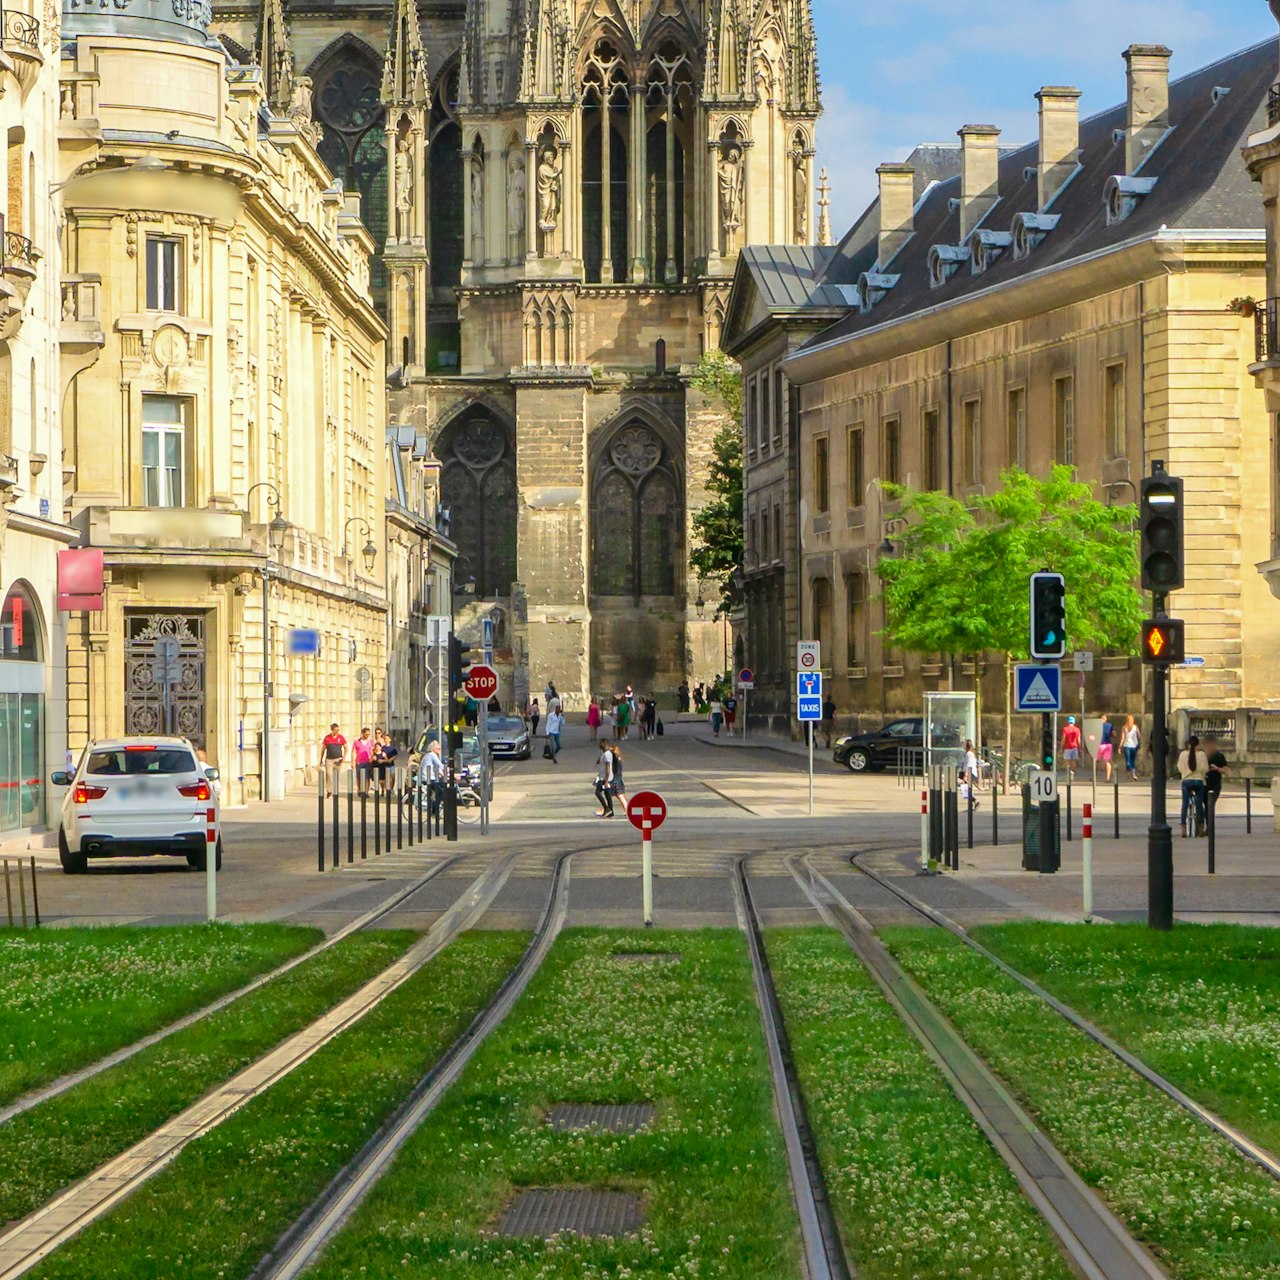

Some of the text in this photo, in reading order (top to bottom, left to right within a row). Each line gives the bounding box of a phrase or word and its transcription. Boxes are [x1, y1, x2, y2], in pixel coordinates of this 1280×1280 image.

[467, 677, 495, 688] STOP
[801, 704, 819, 712] TAXIS
[1035, 776, 1052, 795] 10
